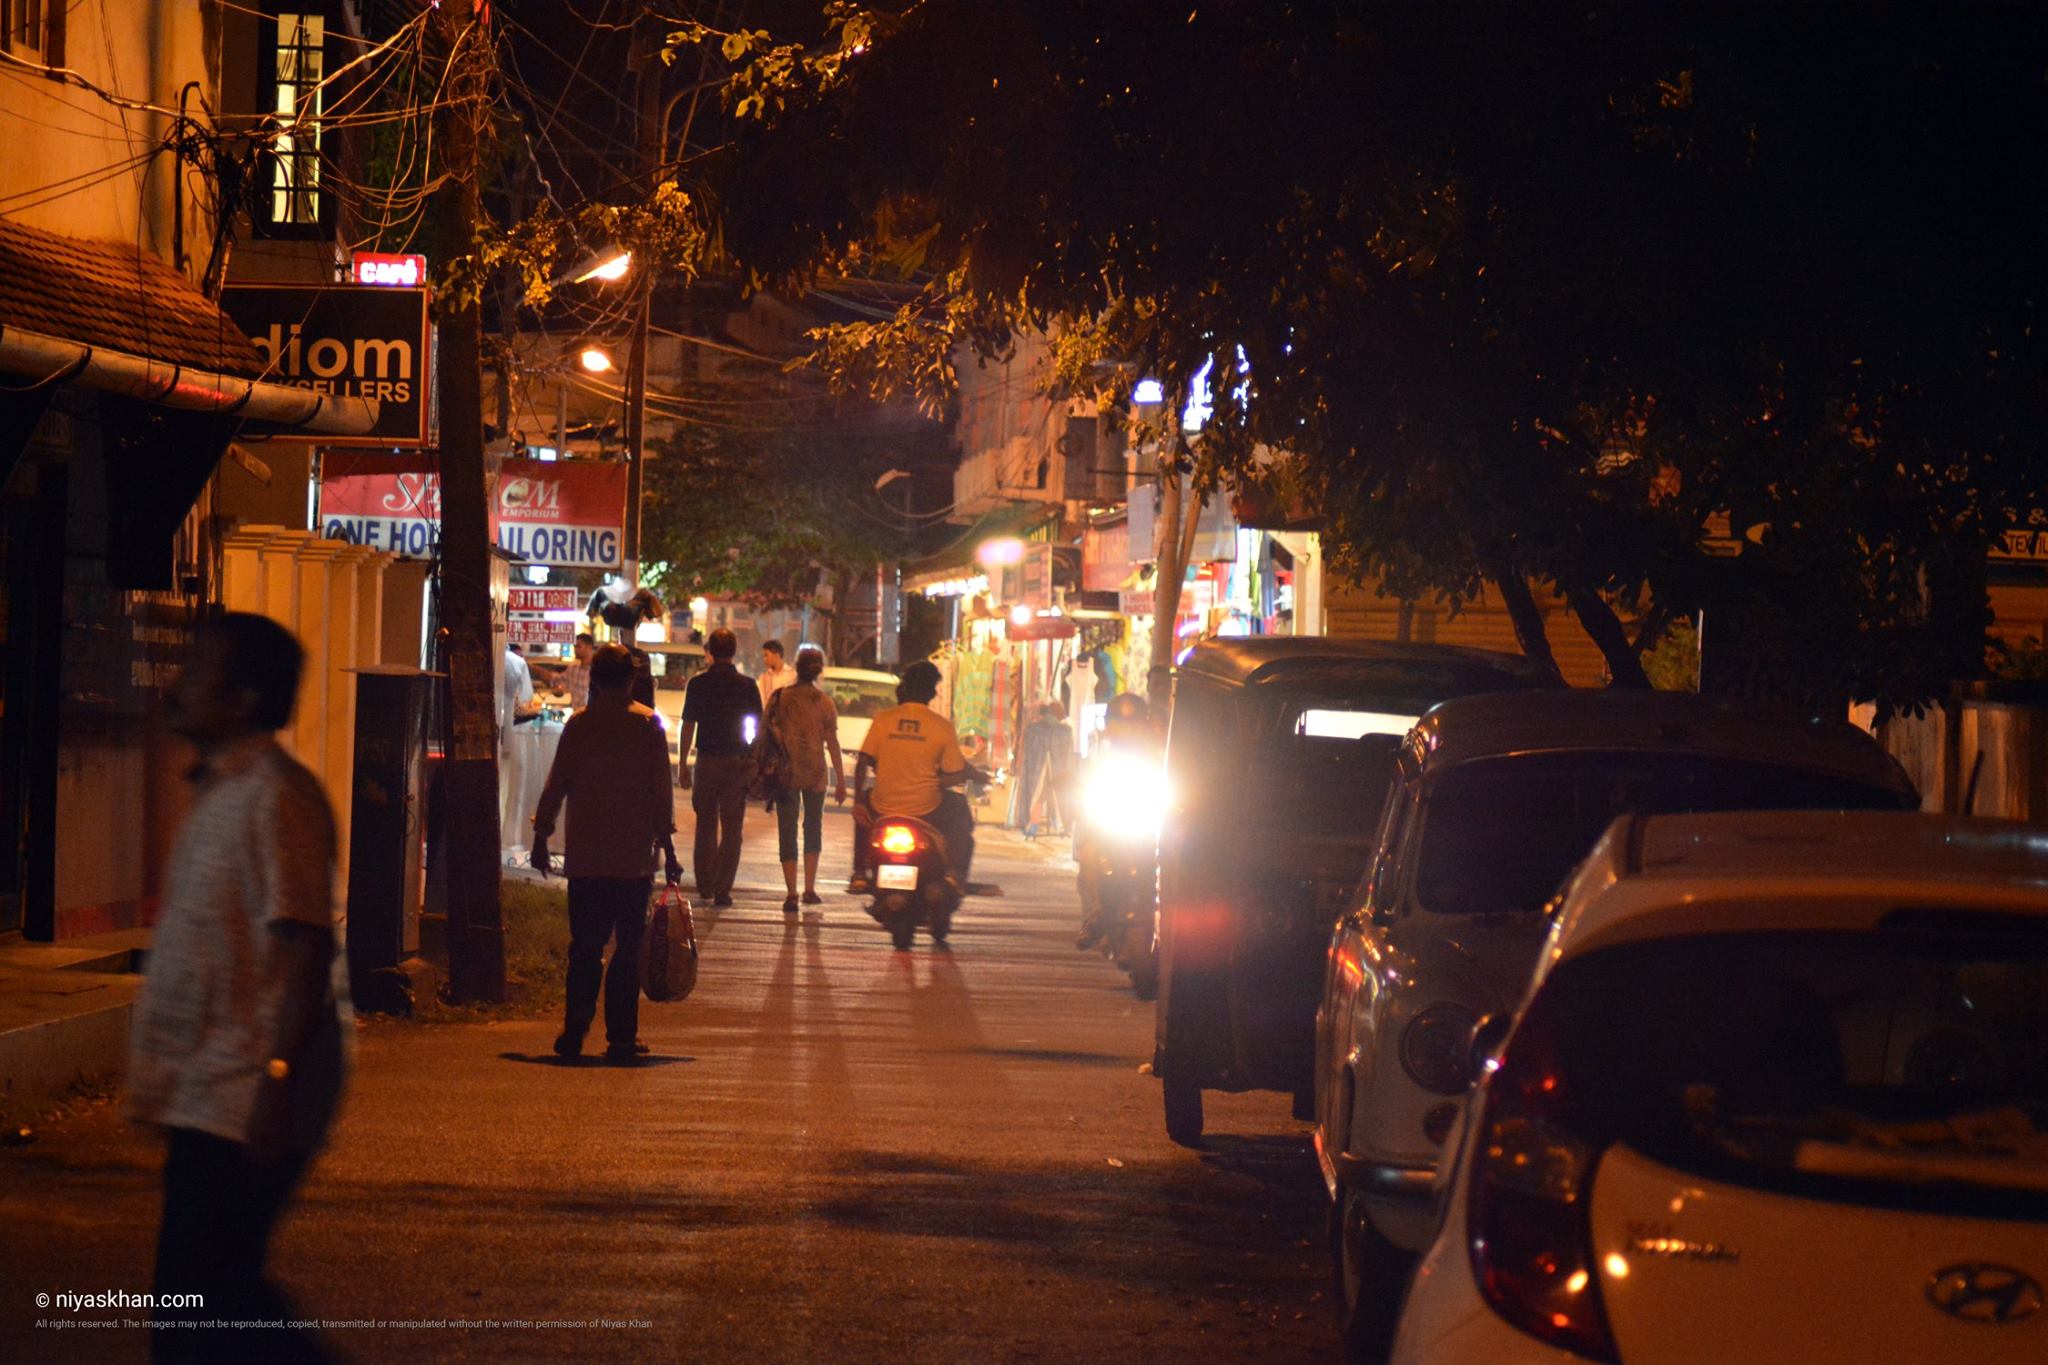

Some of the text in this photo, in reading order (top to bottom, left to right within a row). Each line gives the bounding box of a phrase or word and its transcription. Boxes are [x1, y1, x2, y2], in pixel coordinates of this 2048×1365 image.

[250, 323, 412, 379] diom
[502, 508, 560, 519] EMPORIUM
[326, 519, 380, 551] ONE
